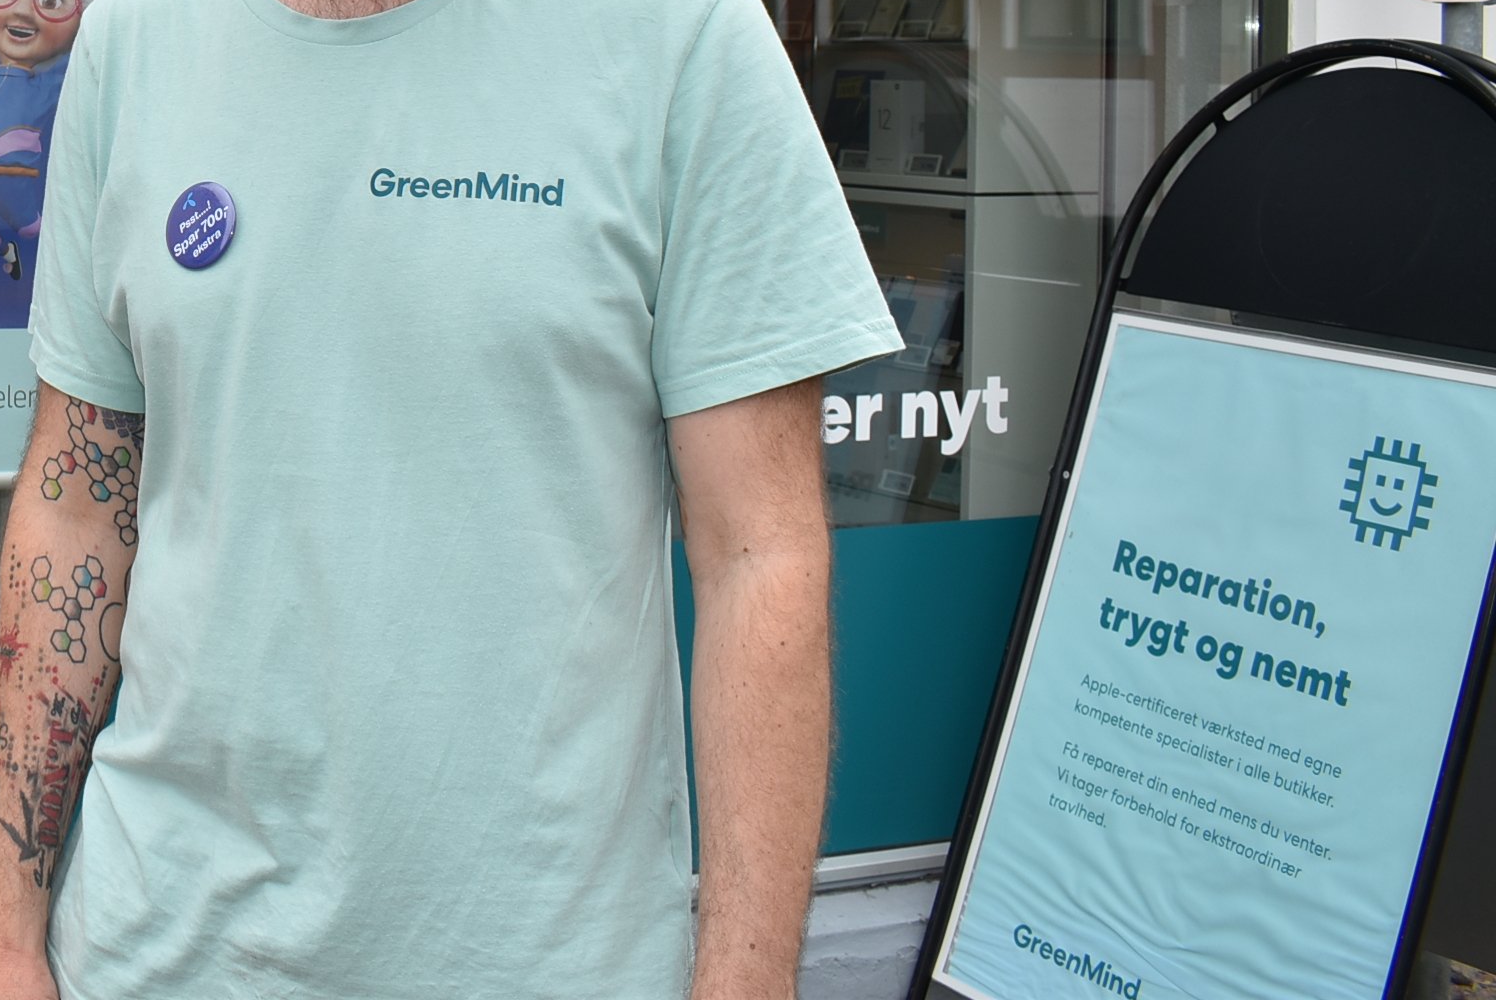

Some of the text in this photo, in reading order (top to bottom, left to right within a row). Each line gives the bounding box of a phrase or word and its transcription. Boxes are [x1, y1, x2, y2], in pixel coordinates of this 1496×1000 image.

[369, 167, 565, 207] GreenMind
[173, 228, 200, 257] Spar
[192, 229, 222, 258] ekstra
[901, 376, 1009, 456] nyt
[1112, 539, 1326, 639] Reparation,
[1099, 597, 1352, 707] trygt og nemt
[1074, 698, 1335, 808] kompetente specialister i alle butikker.
[1081, 674, 1342, 779] Apple-certificeret værksted med egne
[1048, 793, 1107, 829] travlhed.
[1057, 766, 1303, 879] Vi tager forbehold for ekstraordinær
[1062, 741, 1332, 861] Få repareret din enhed mens du venter.
[1013, 924, 1142, 1000] GreenMind
